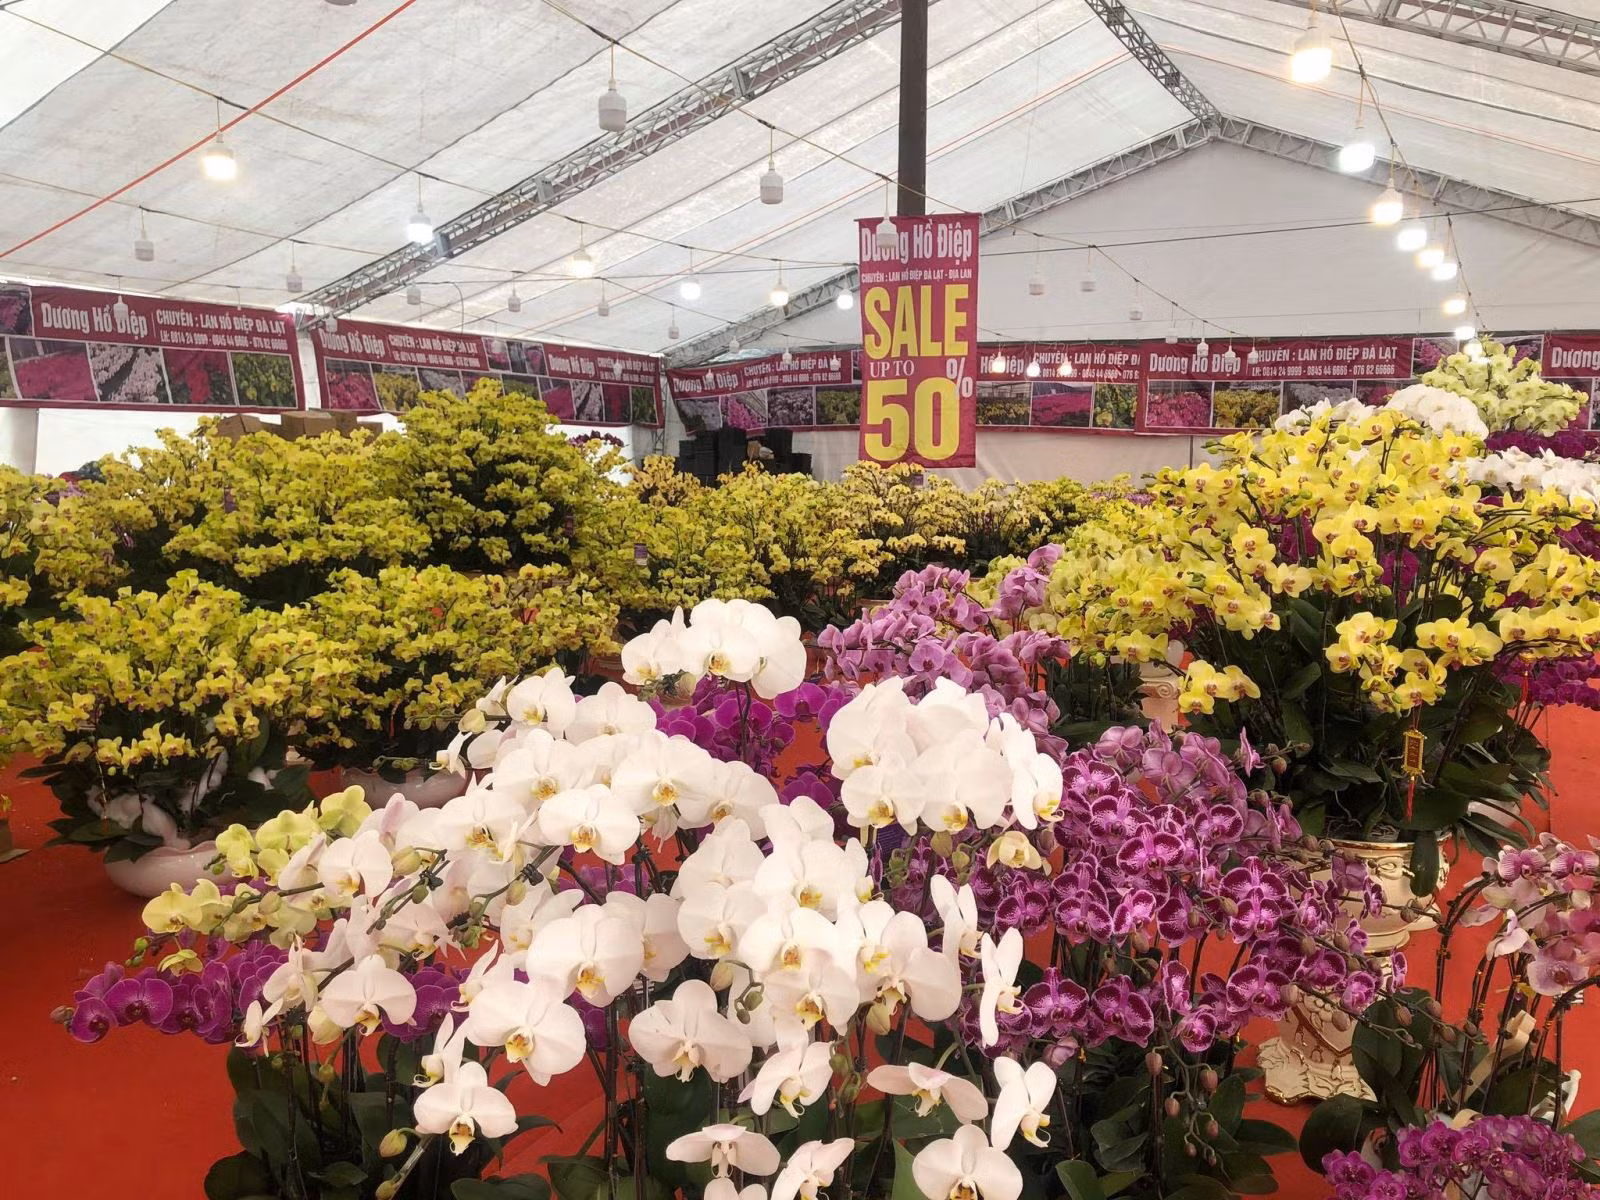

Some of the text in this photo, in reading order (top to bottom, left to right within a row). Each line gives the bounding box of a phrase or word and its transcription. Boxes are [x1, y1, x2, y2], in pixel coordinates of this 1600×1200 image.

[913, 219, 933, 259] Hồ
[937, 222, 972, 265] Điệp
[889, 271, 900, 282] LAN
[960, 268, 972, 279] LAN
[41, 302, 90, 334] Dương
[156, 308, 194, 327] CHUYÊN
[200, 314, 219, 330] LAN
[864, 284, 969, 360] SALE
[1075, 352, 1092, 364] LAN
[1149, 353, 1189, 375] Dương
[1298, 349, 1317, 361] LAN
[1336, 345, 1360, 363] ĐIỆP
[1361, 344, 1376, 360] ĐÀ
[1379, 346, 1398, 362] LẠT
[870, 360, 915, 378] UP TO
